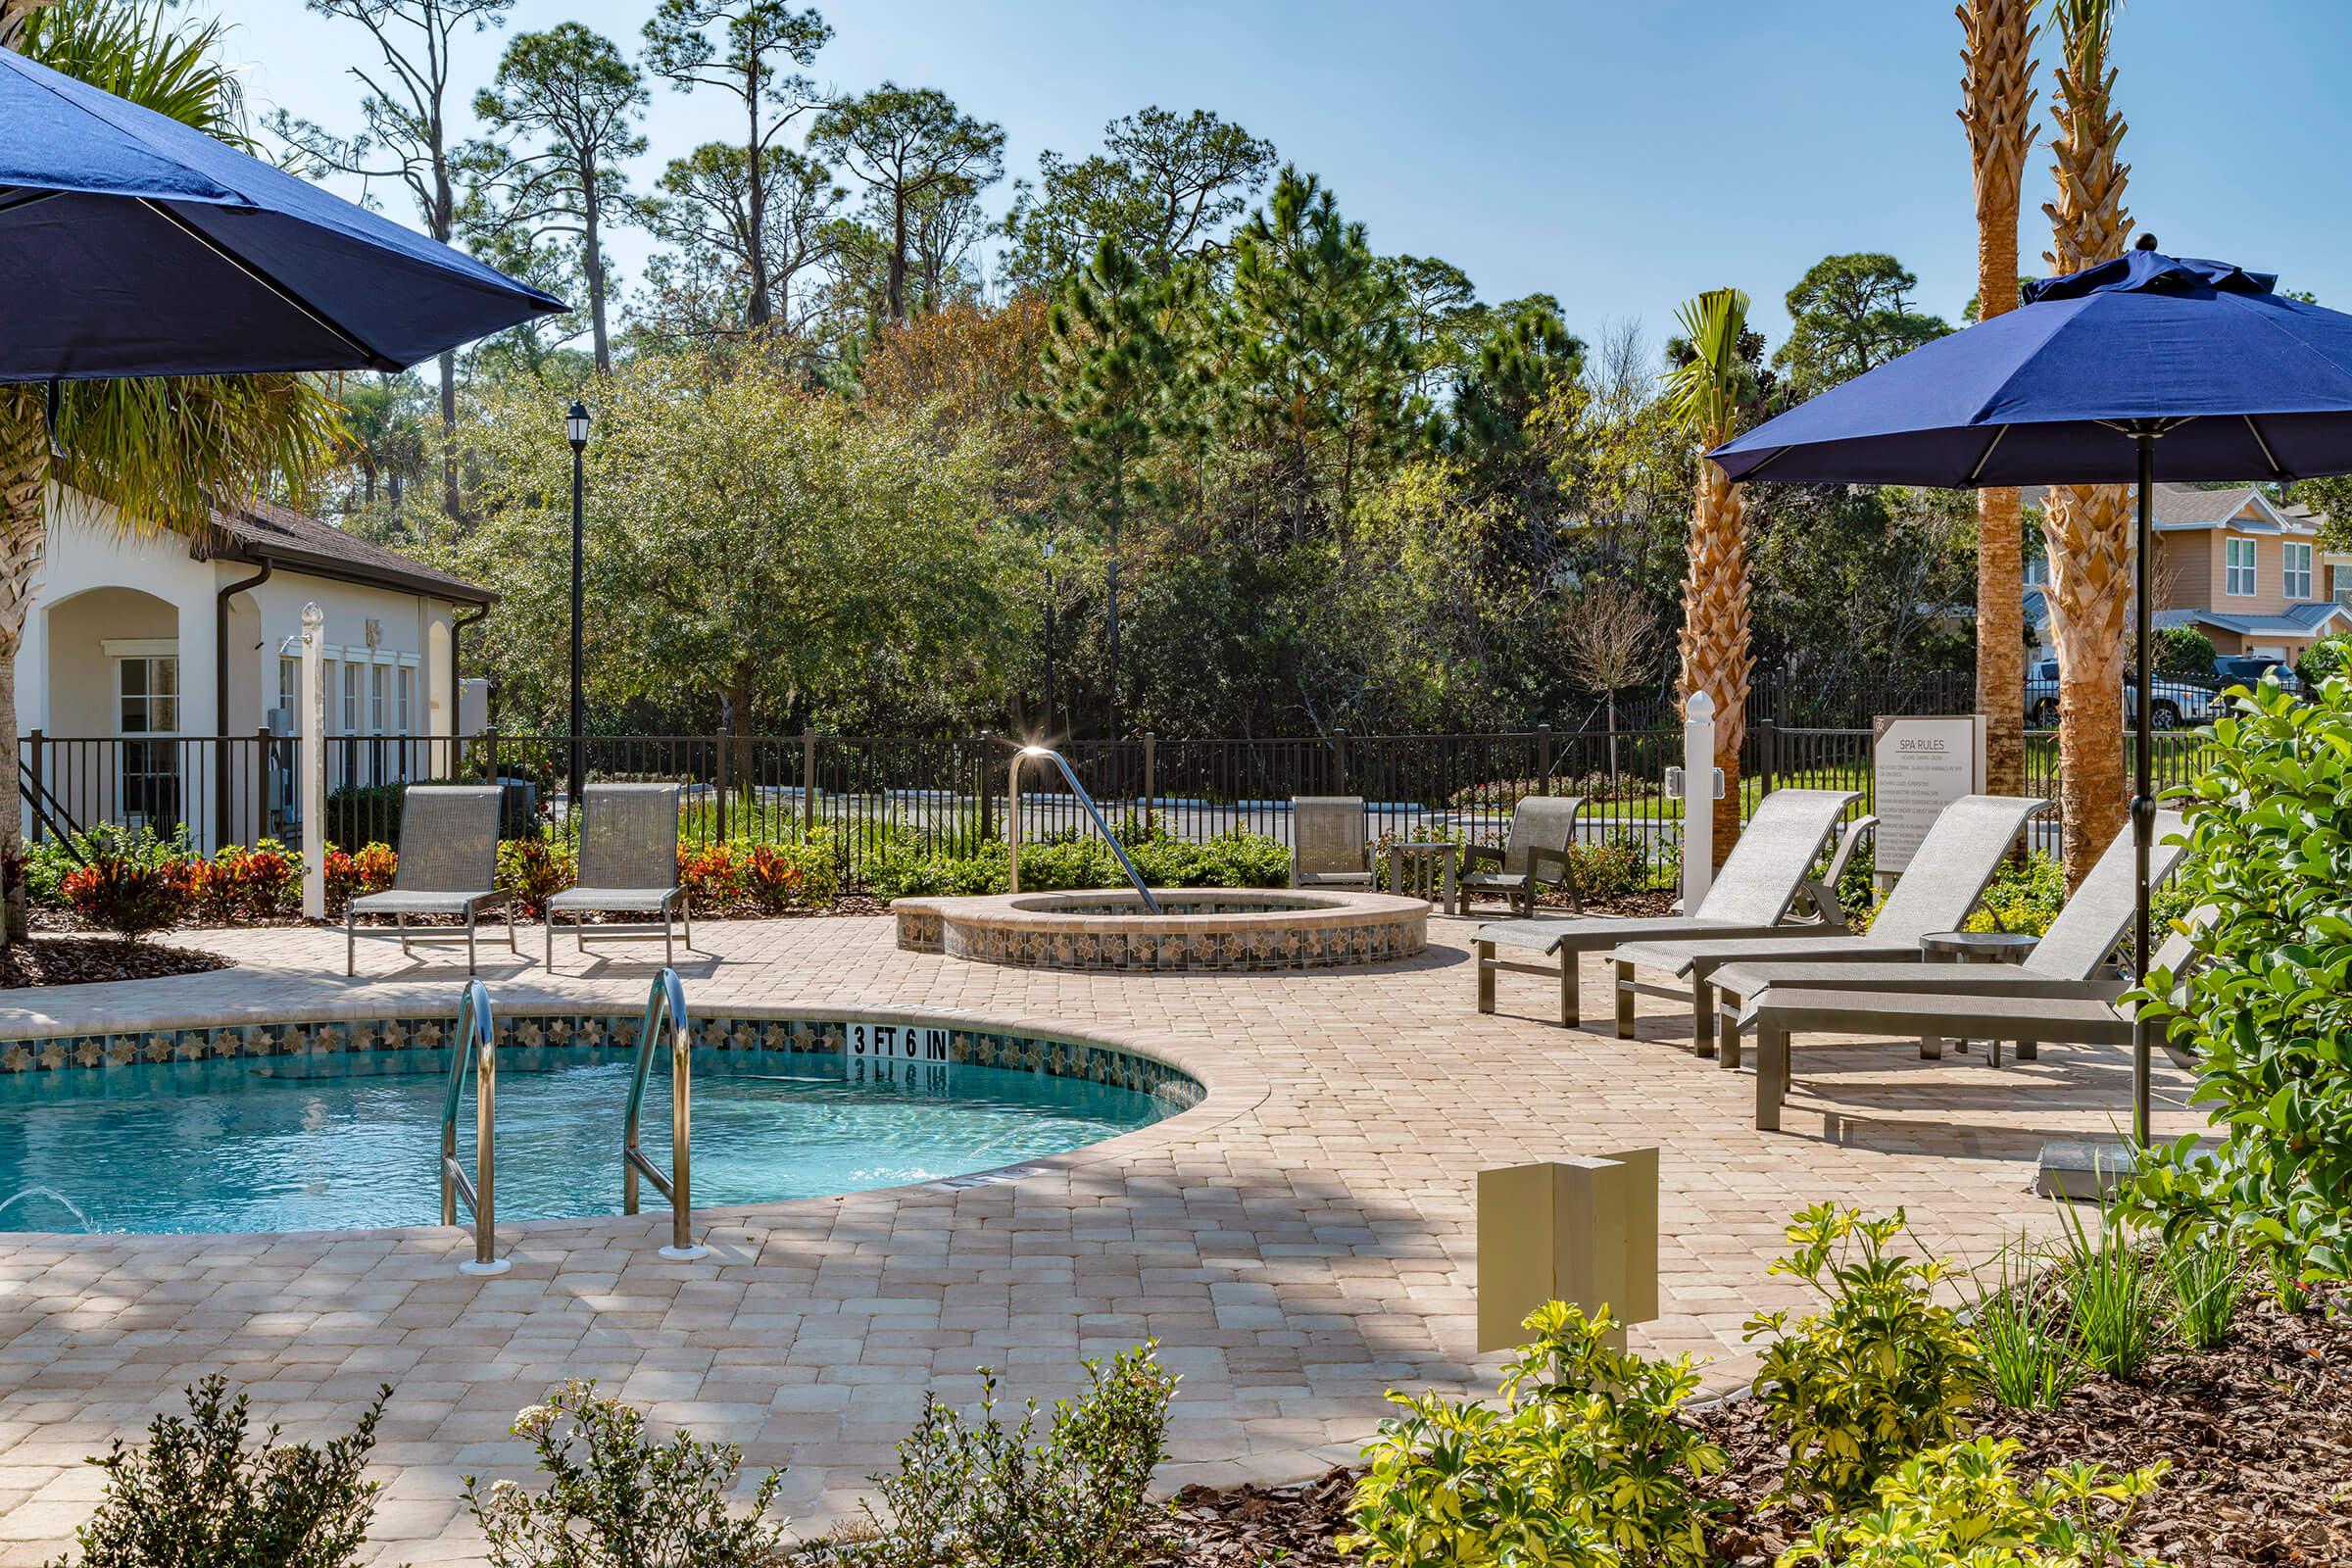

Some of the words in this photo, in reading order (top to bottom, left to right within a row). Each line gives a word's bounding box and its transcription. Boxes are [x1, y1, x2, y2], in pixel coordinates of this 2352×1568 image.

[1899, 739, 1916, 750] SPA
[1918, 739, 1944, 750] RULES
[855, 1025, 864, 1054] 3
[874, 1026, 897, 1056] FT
[906, 1028, 916, 1057] 6
[927, 1030, 946, 1060] IN
